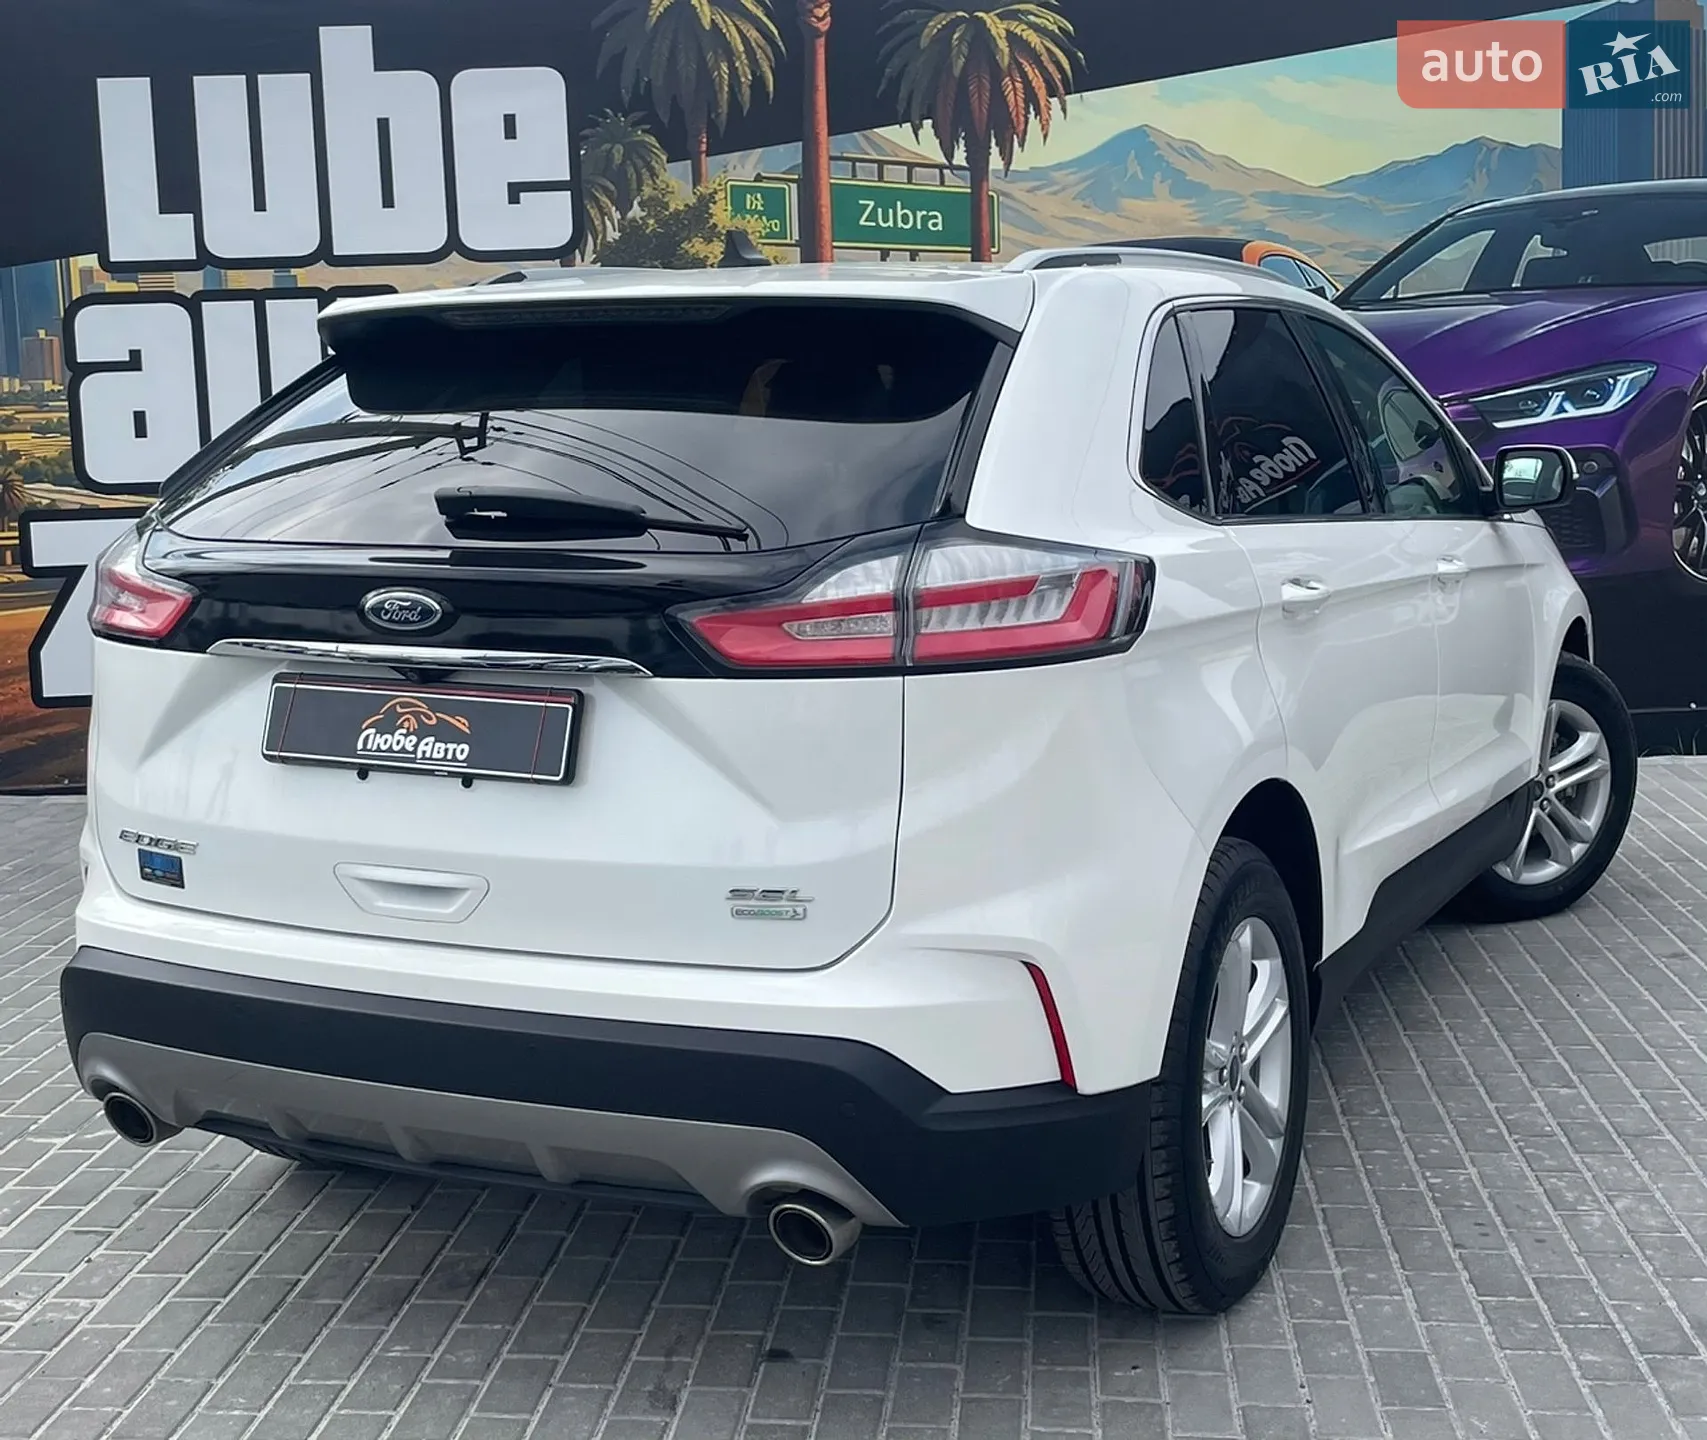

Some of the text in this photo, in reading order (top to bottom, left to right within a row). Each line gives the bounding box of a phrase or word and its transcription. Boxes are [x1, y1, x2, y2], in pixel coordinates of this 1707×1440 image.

[96, 24, 575, 263] Lube
[858, 199, 944, 232] Zubra
[381, 599, 422, 623] Ford
[119, 828, 199, 855] EDGE
[725, 886, 815, 903] SEL
